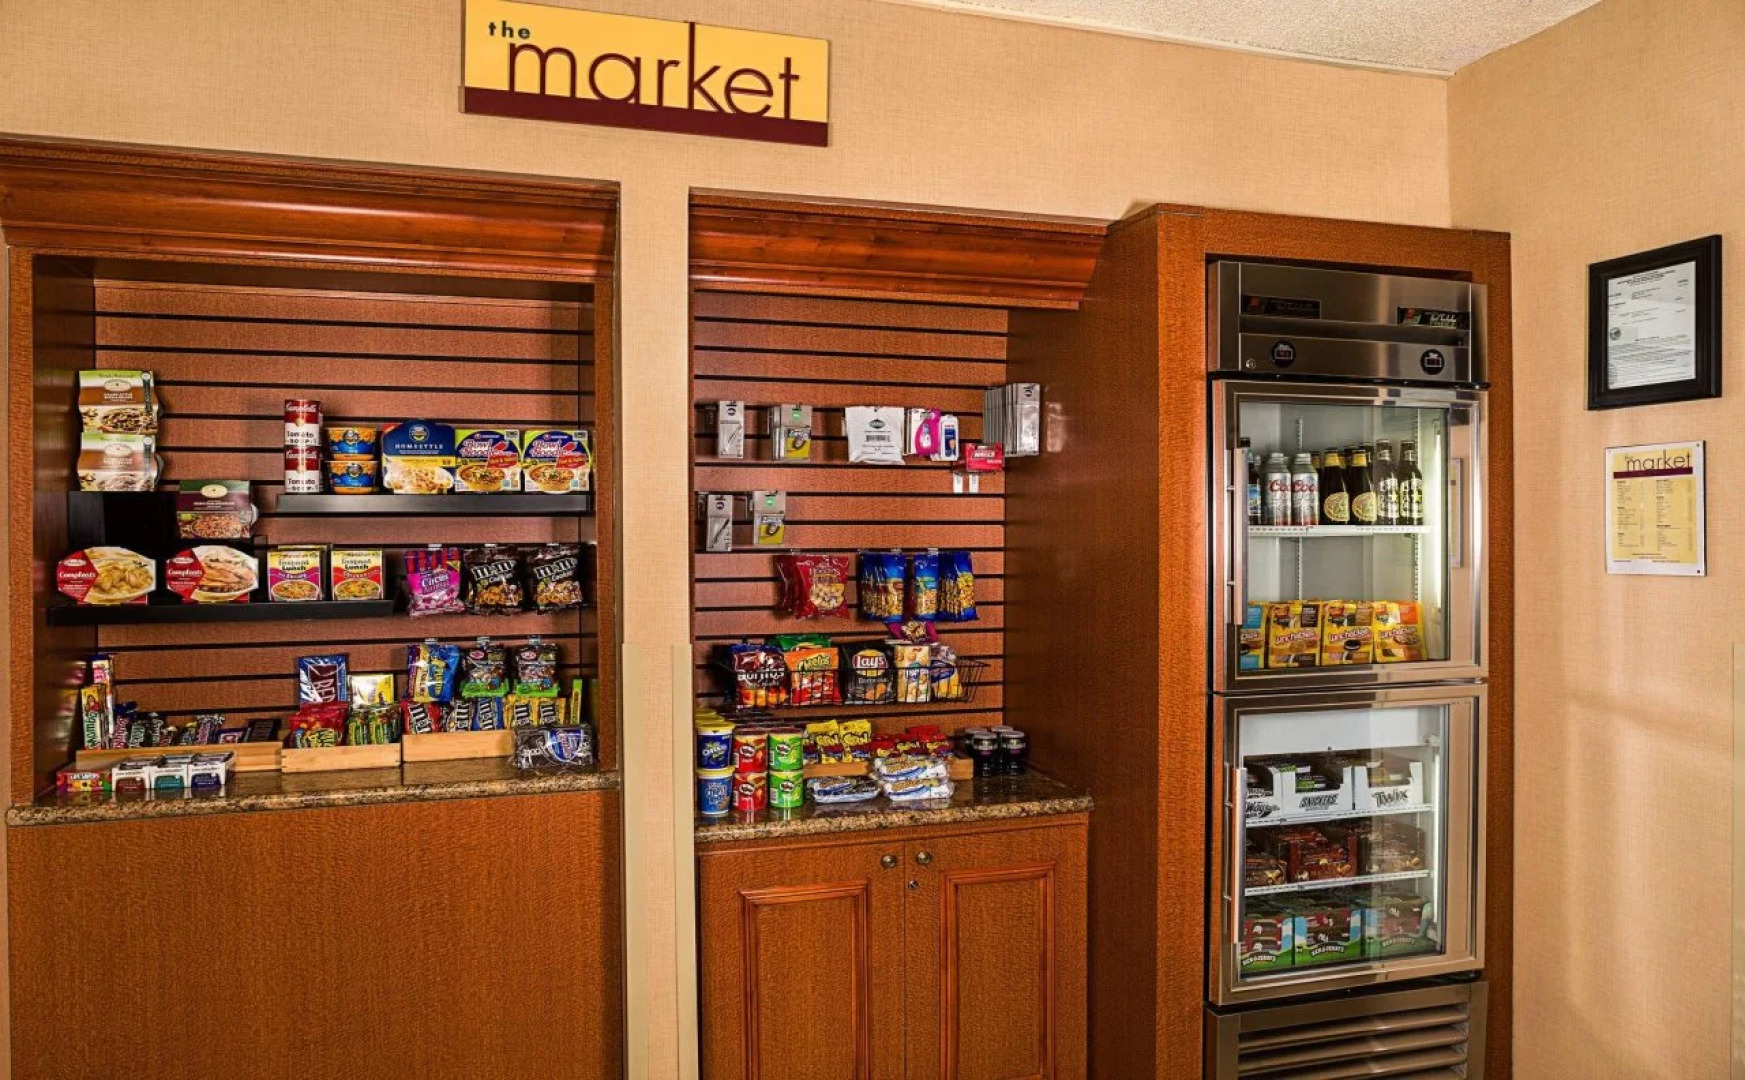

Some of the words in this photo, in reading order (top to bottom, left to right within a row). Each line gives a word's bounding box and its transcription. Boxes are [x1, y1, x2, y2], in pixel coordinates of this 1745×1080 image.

[488, 20, 531, 40] the
[508, 22, 801, 120] market
[1625, 449, 1691, 471] market
[1371, 788, 1408, 808] Twix
